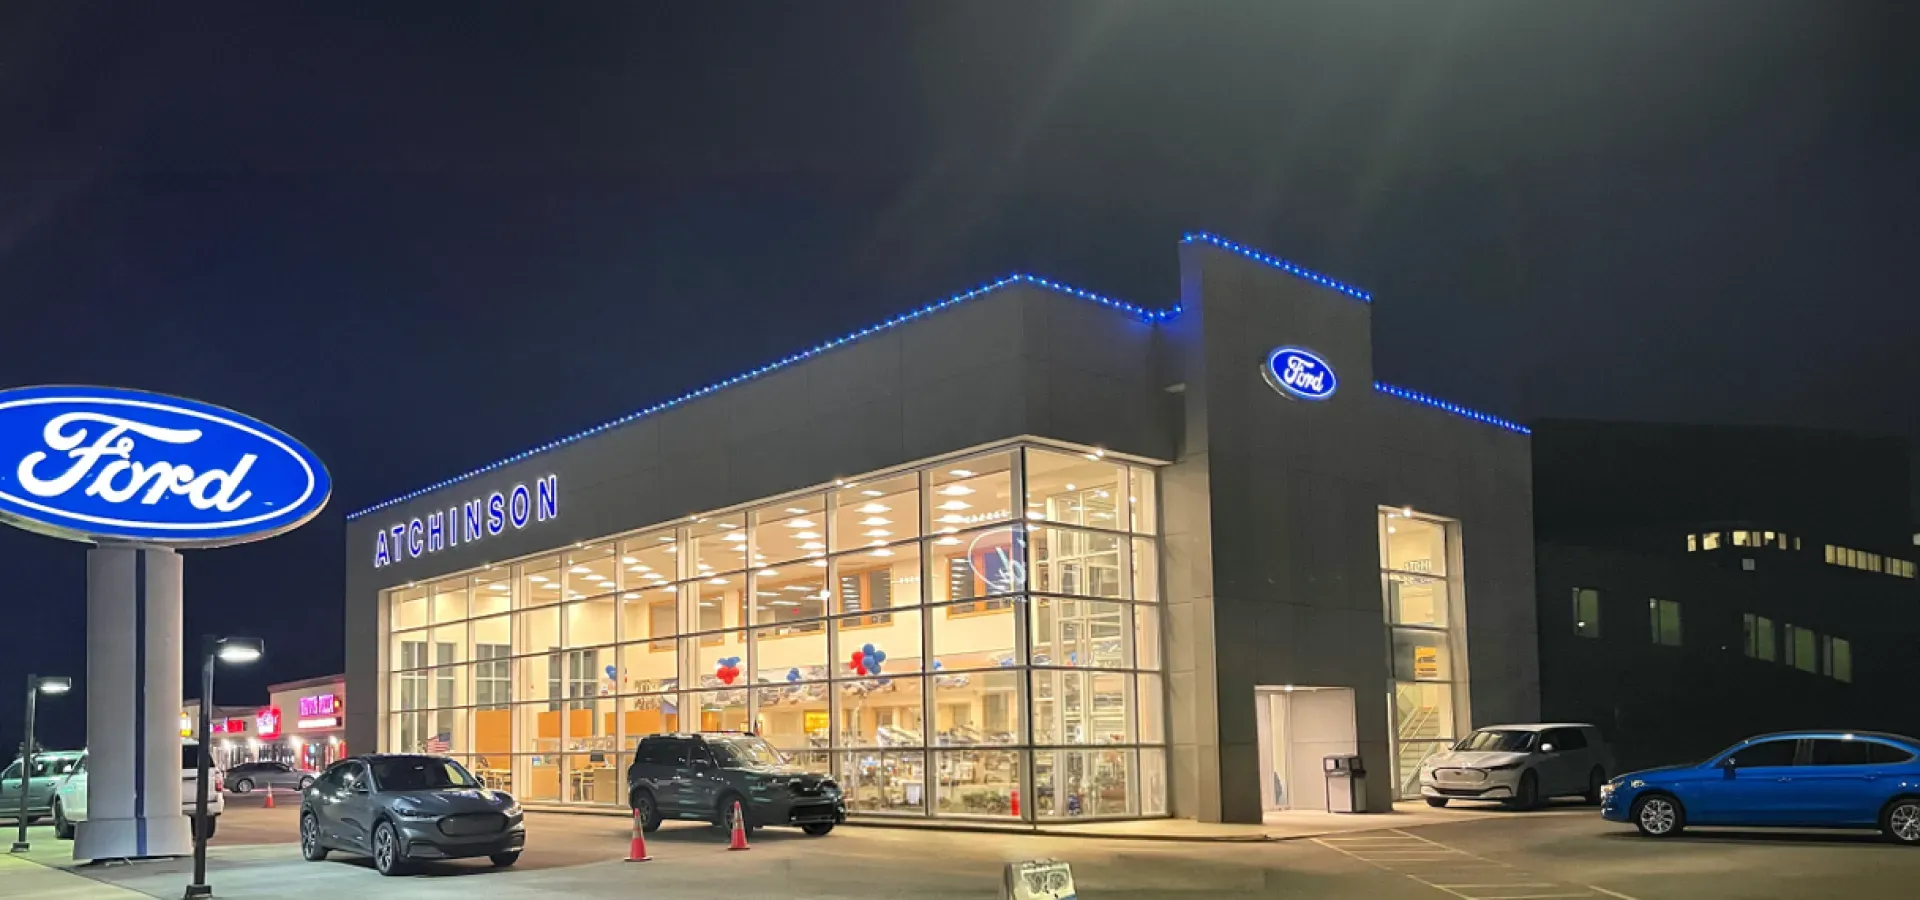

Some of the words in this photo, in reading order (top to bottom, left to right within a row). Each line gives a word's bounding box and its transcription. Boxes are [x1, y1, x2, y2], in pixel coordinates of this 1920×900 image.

[1284, 356, 1324, 392] Ford
[17, 411, 258, 512] Ford
[374, 474, 557, 568] ATCHINSON
